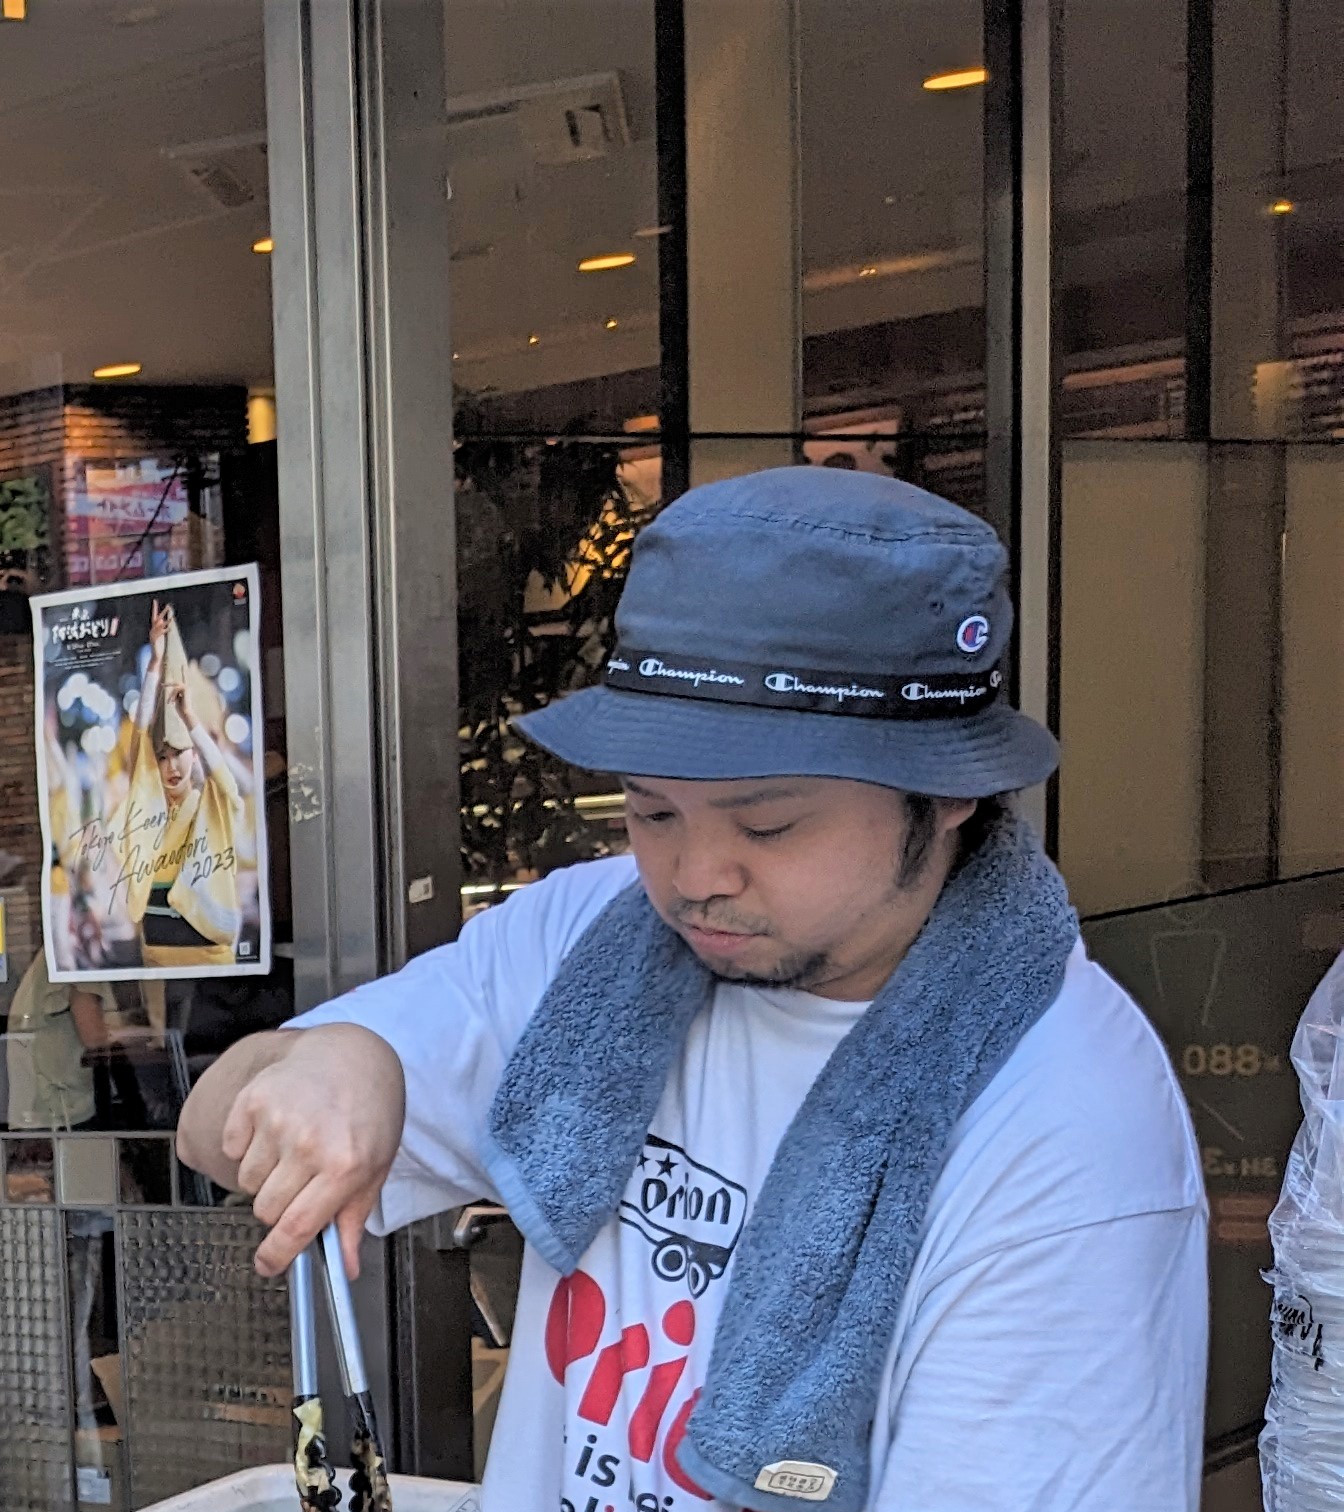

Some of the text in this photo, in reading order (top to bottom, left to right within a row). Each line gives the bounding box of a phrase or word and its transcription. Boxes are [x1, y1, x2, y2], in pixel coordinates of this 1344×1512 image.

[639, 658, 744, 688] Champion
[765, 672, 885, 703] Champion
[902, 682, 987, 705] Champio
[190, 847, 235, 886] 2023
[575, 1434, 620, 1488] is
